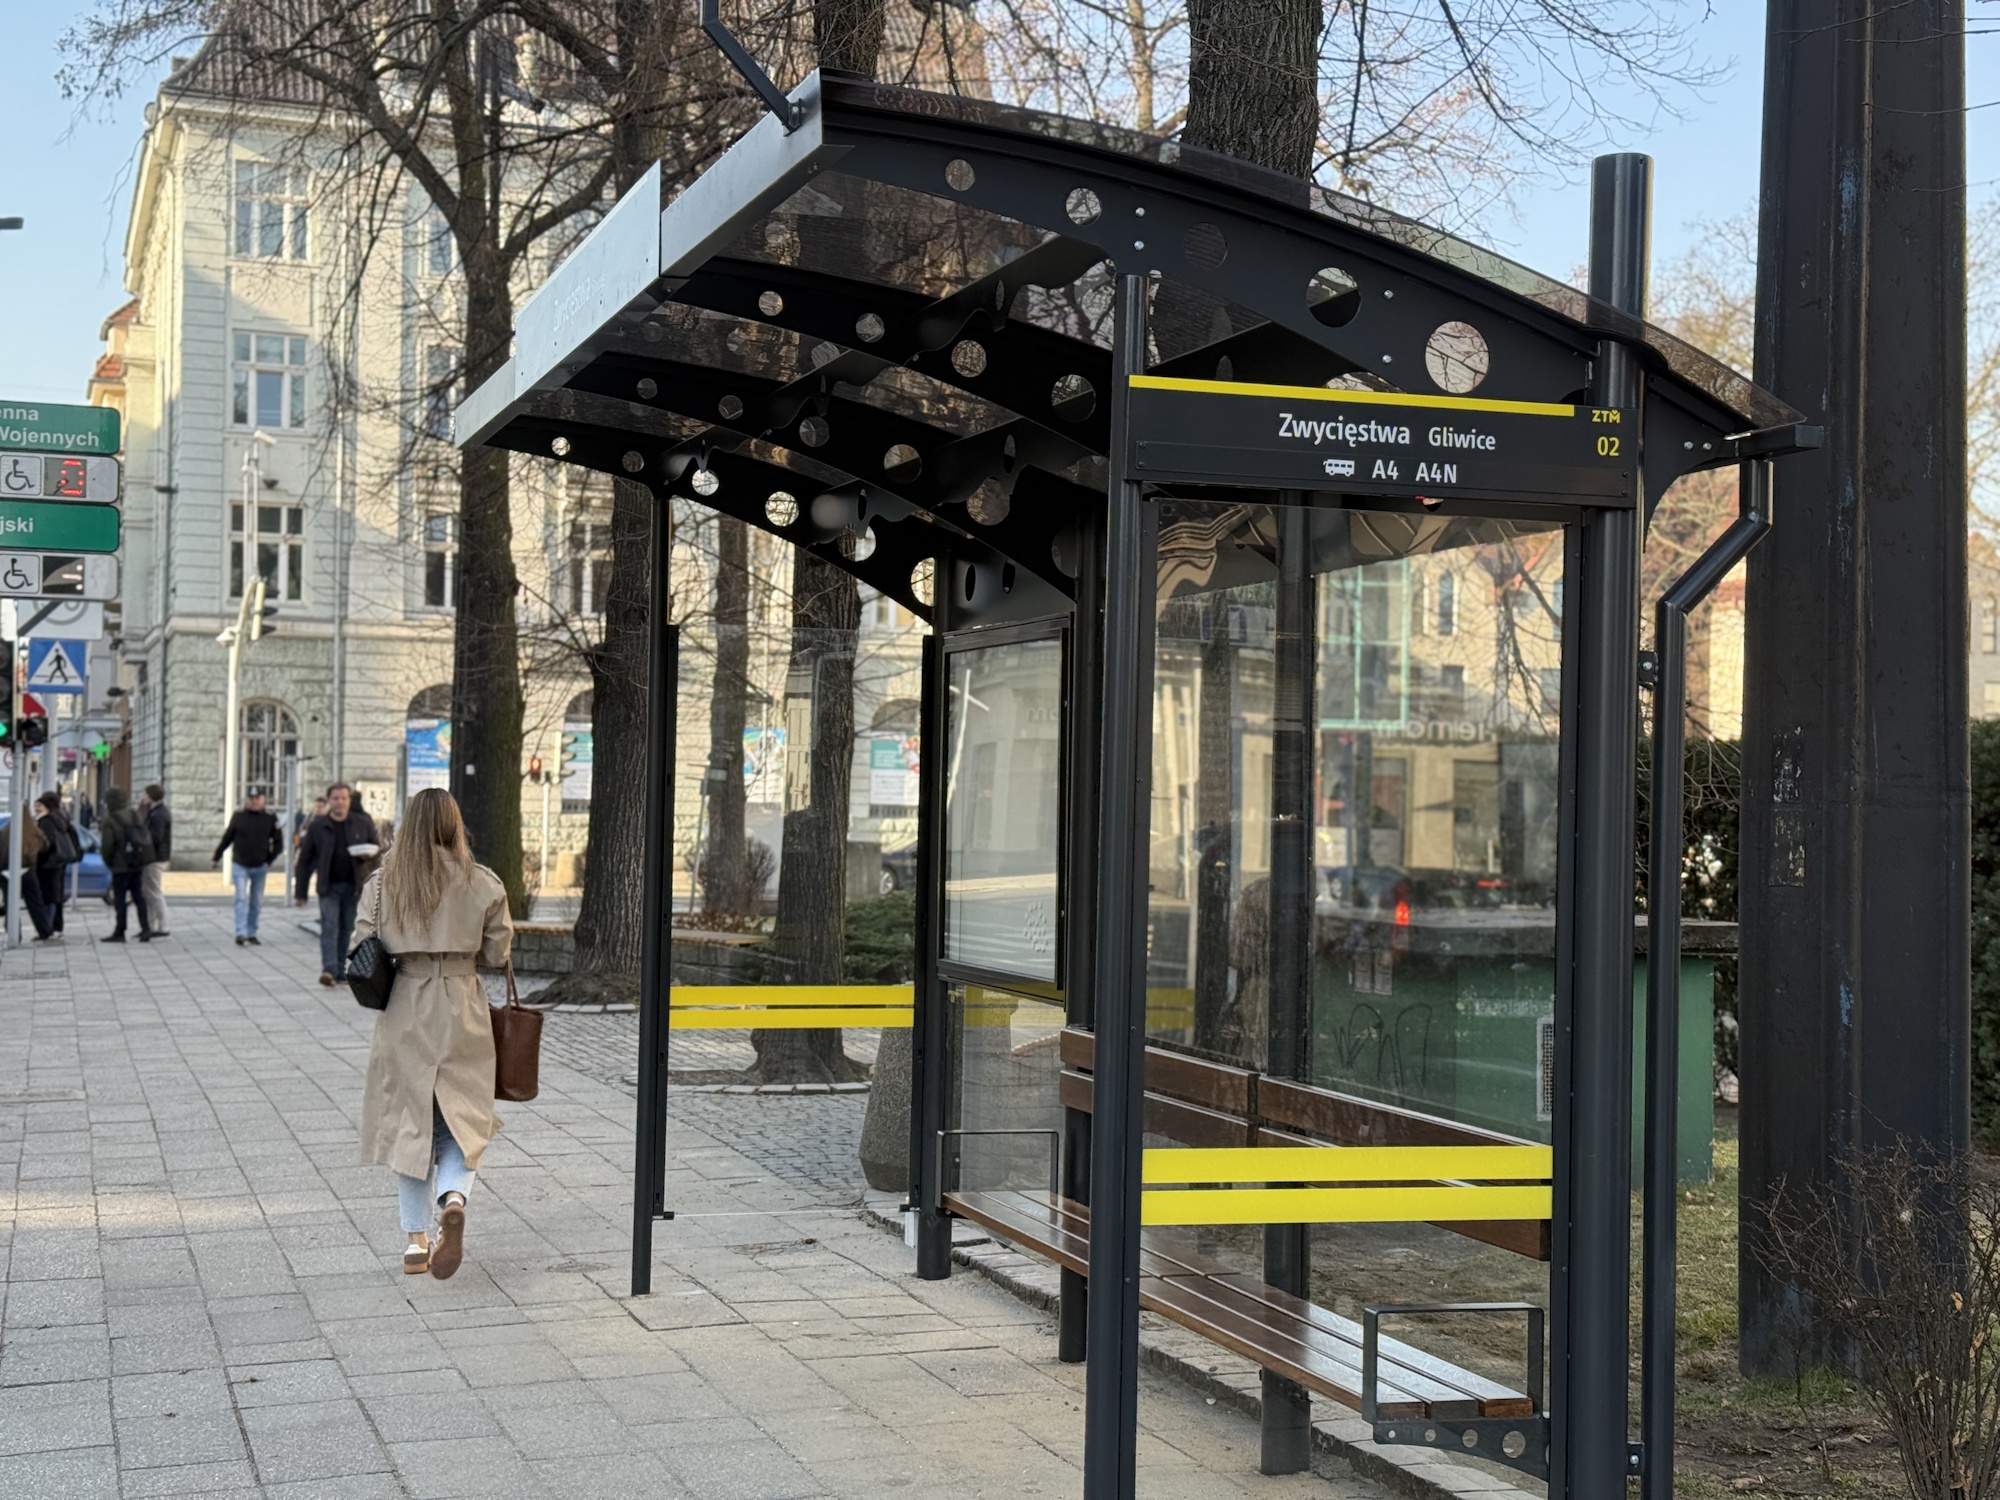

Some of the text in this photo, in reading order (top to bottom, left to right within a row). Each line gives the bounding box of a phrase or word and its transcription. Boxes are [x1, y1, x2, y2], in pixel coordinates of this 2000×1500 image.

[1591, 409, 1621, 424] ZTM
[1278, 412, 1496, 450] Zwycięstwa Gliwice
[1597, 436, 1620, 457] 02
[1371, 458, 1457, 484] A4 A4N
